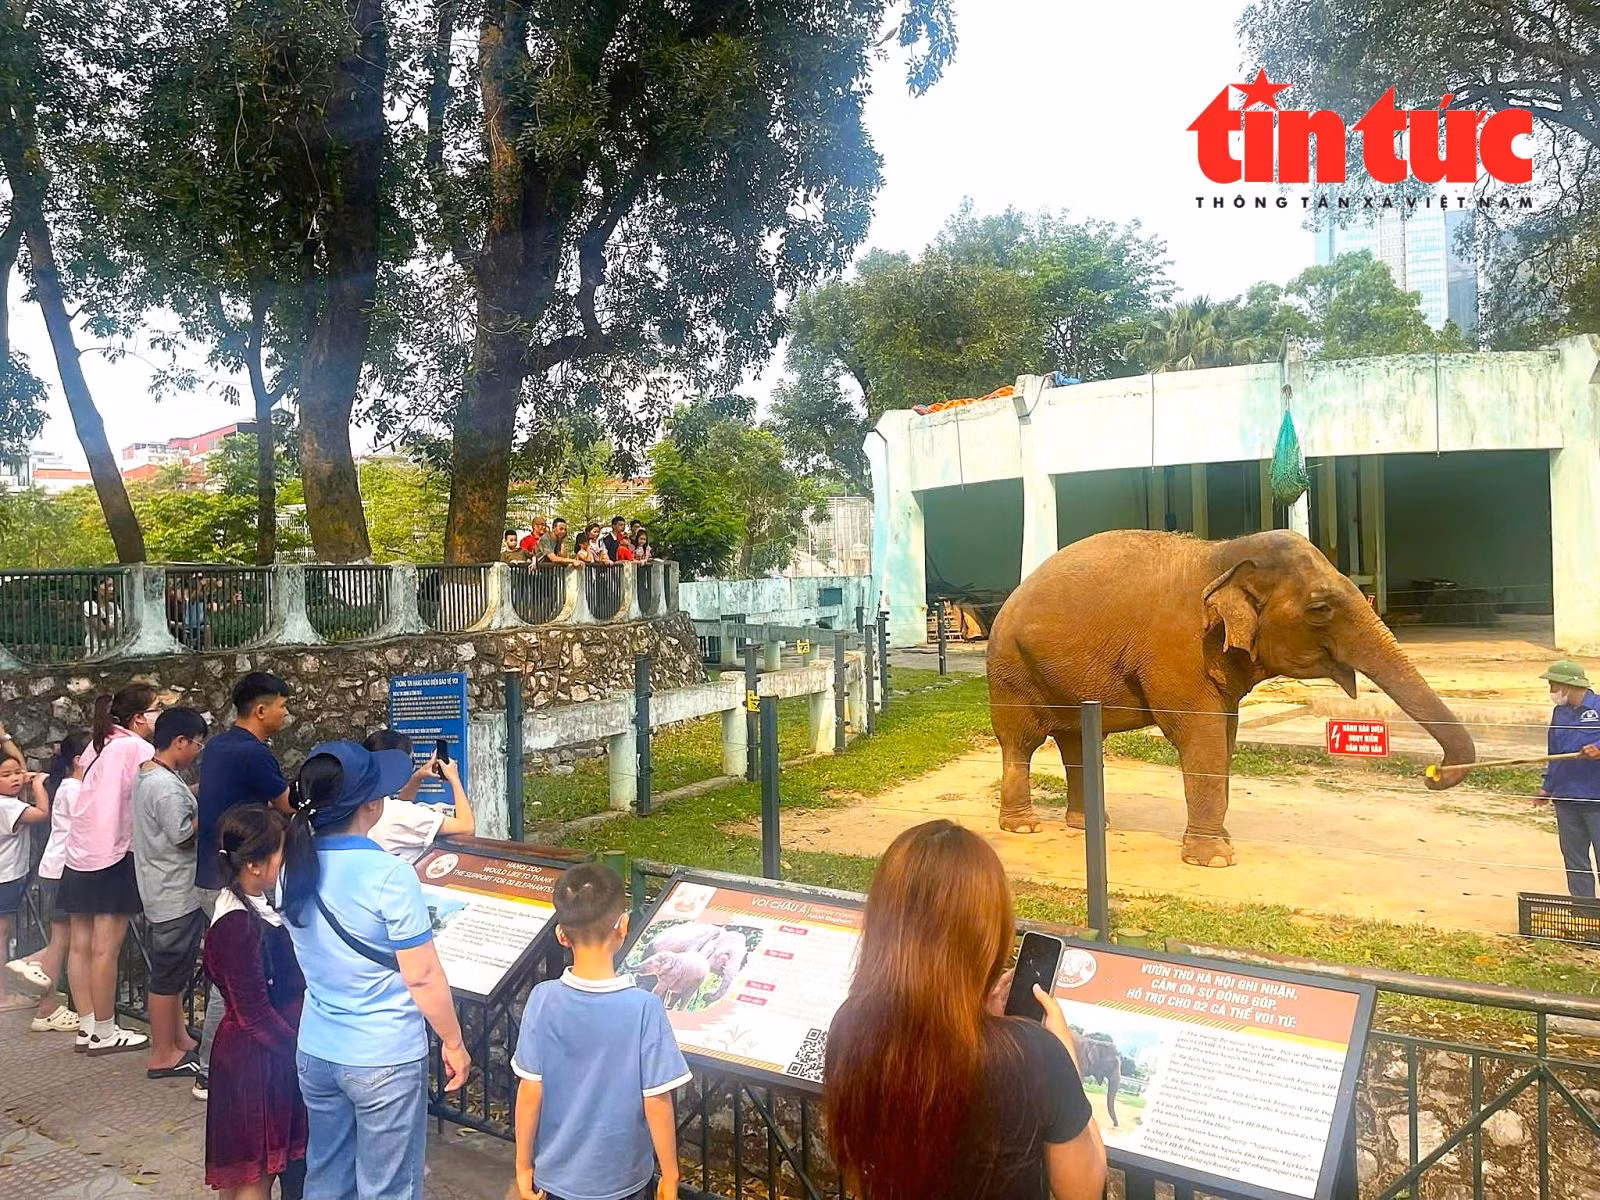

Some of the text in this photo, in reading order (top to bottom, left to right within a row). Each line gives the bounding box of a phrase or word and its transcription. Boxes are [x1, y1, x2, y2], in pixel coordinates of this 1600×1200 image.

[453, 869, 465, 877] THE
[464, 872, 493, 881] SUPPORT
[483, 866, 507, 875] WOULD
[531, 875, 554, 883] THANK
[506, 862, 542, 873] HANOI ZOO
[752, 897, 770, 907] VOI
[770, 900, 798, 911] CHÂU
[1142, 963, 1171, 977] VƯỜN
[1214, 976, 1235, 988] NỘI
[1237, 980, 1258, 992] GHI
[1179, 983, 1196, 995] ƠN
[1197, 987, 1216, 1000] SỰ
[1145, 992, 1166, 1005] TRỢ
[1168, 996, 1191, 1008] CHO
[1193, 1001, 1208, 1012] 02
[1255, 1012, 1275, 1024] VOI
